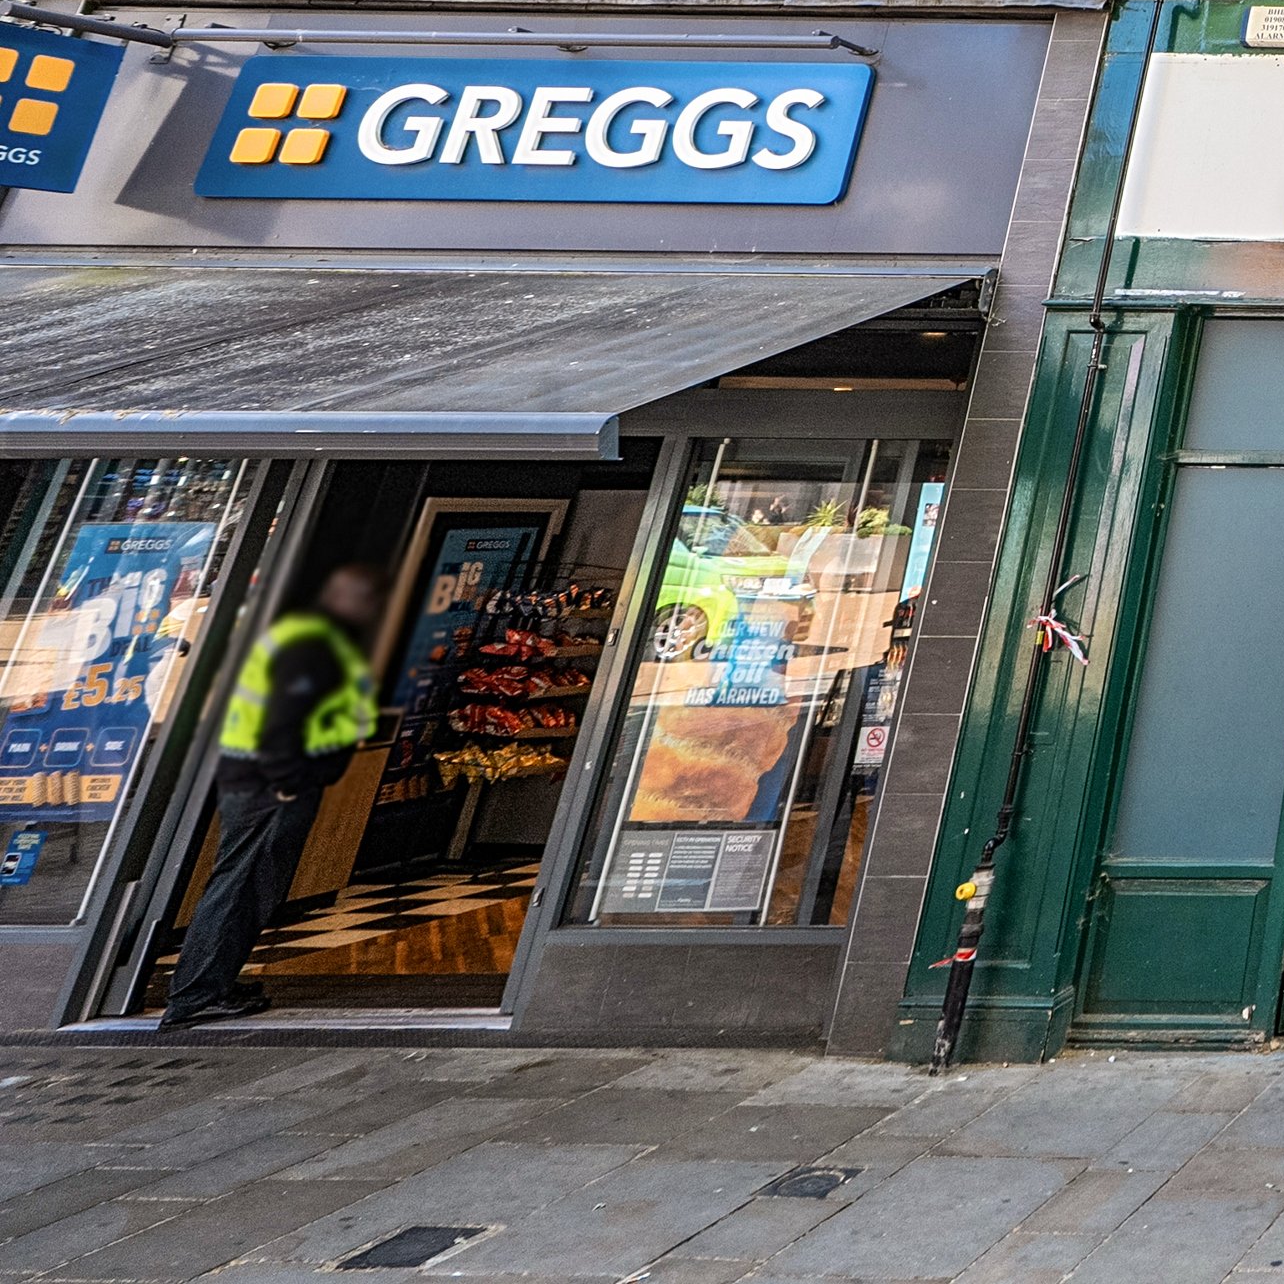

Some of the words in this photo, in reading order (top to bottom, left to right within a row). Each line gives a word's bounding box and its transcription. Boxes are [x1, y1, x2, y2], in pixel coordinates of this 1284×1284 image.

[357, 82, 826, 170] GREGGS
[120, 539, 173, 551] GREGGS
[475, 540, 511, 550] GREGGS
[747, 620, 785, 637] NEW
[692, 638, 796, 661] Chicken
[711, 661, 769, 684] Roll
[60, 662, 145, 710] £5.25
[685, 687, 714, 705] HAS
[716, 687, 780, 705] ARRIVED
[725, 843, 753, 853] NOTICE
[727, 835, 762, 844] SECURITY
